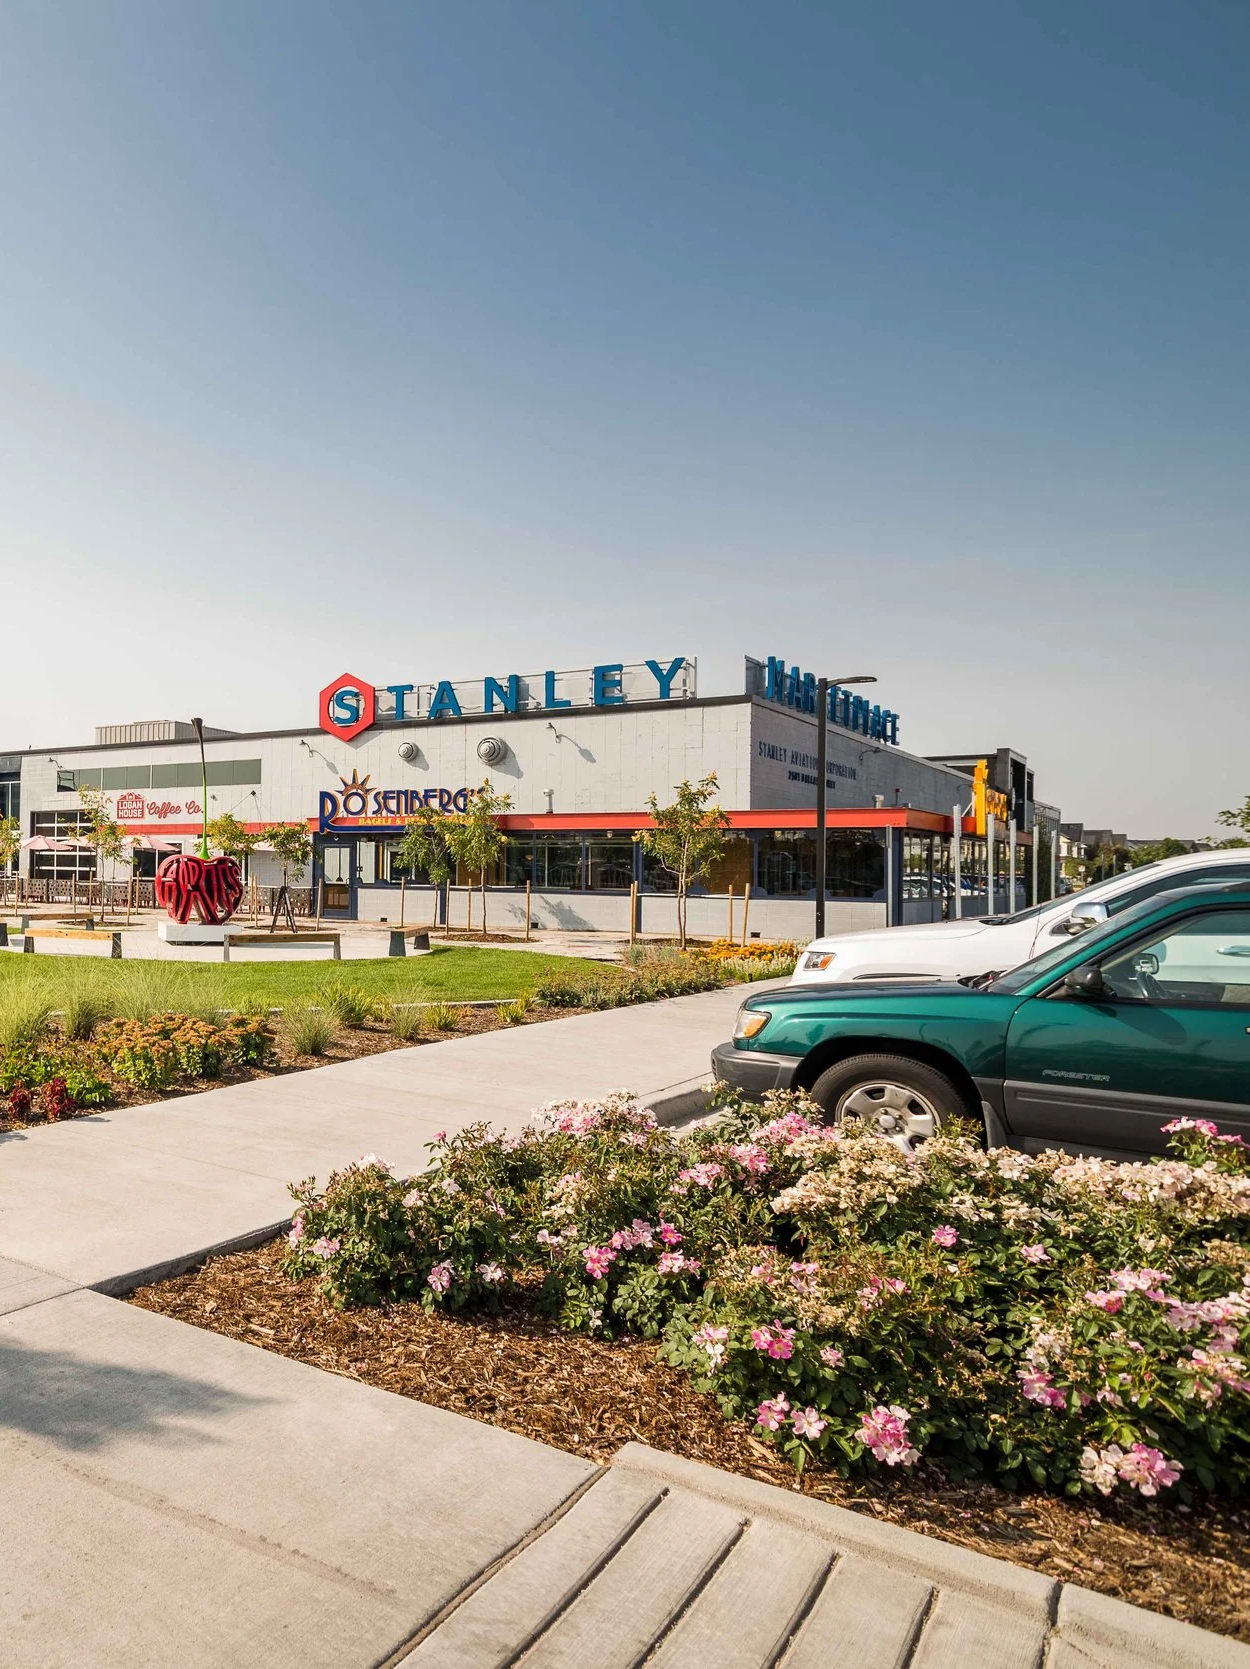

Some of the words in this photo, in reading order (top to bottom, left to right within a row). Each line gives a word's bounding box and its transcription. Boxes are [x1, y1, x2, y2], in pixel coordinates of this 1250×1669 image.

[333, 657, 686, 725] STANLEY
[767, 656, 900, 746] MARETPLACE
[758, 740, 787, 763] STANLEY
[790, 750, 819, 771] AVIATIO
[119, 801, 142, 810] LOGAN
[119, 809, 142, 818] HOUSE
[146, 801, 182, 819] Coffee
[185, 800, 204, 815] Co.
[1042, 1069, 1111, 1082] FORESTER
